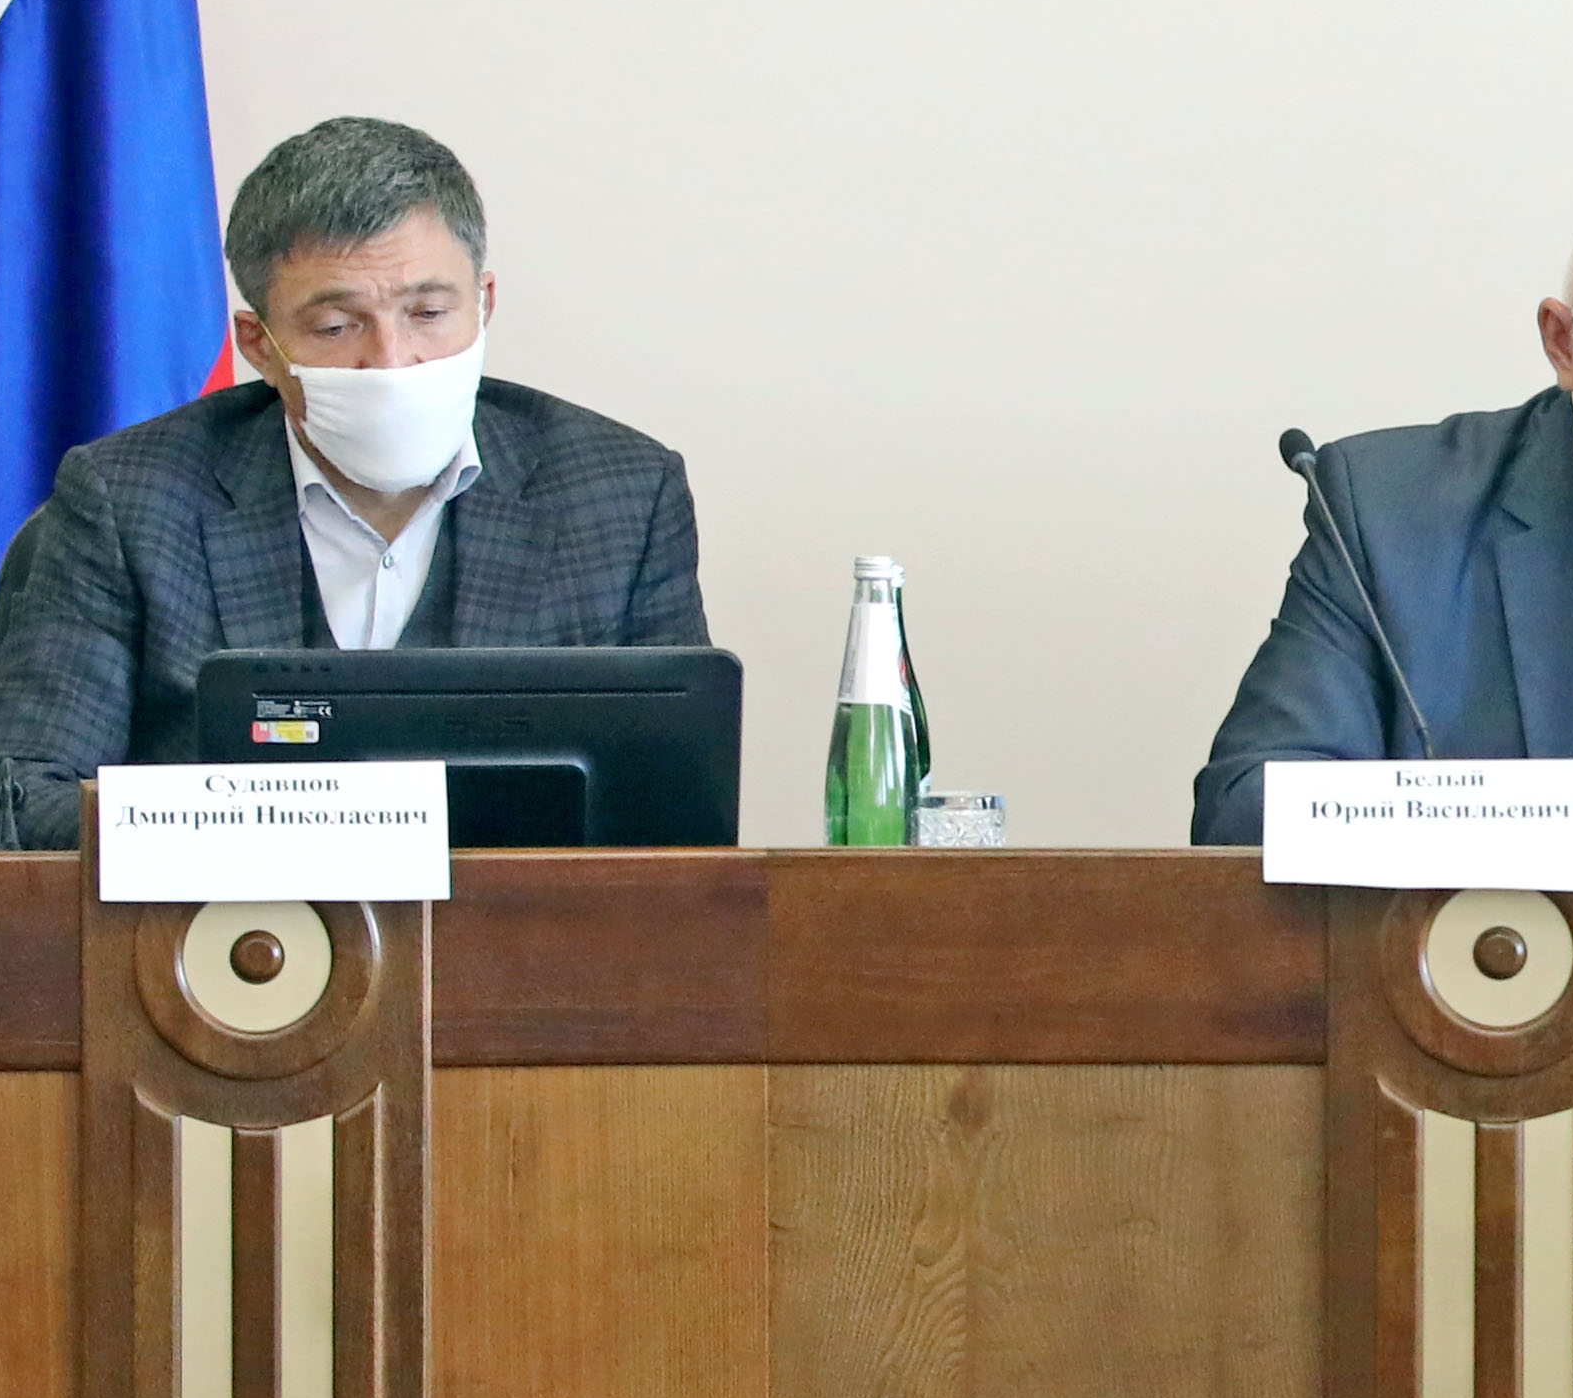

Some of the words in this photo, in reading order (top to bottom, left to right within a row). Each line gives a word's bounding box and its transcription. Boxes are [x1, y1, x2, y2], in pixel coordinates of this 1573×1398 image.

[204, 775, 340, 798] Судавцов
[1395, 768, 1484, 787] Белый
[115, 805, 244, 831] Дмитрий
[256, 805, 427, 825] Николаевич
[1311, 799, 1394, 824] Юрий
[1406, 800, 1569, 819] Васильевич
